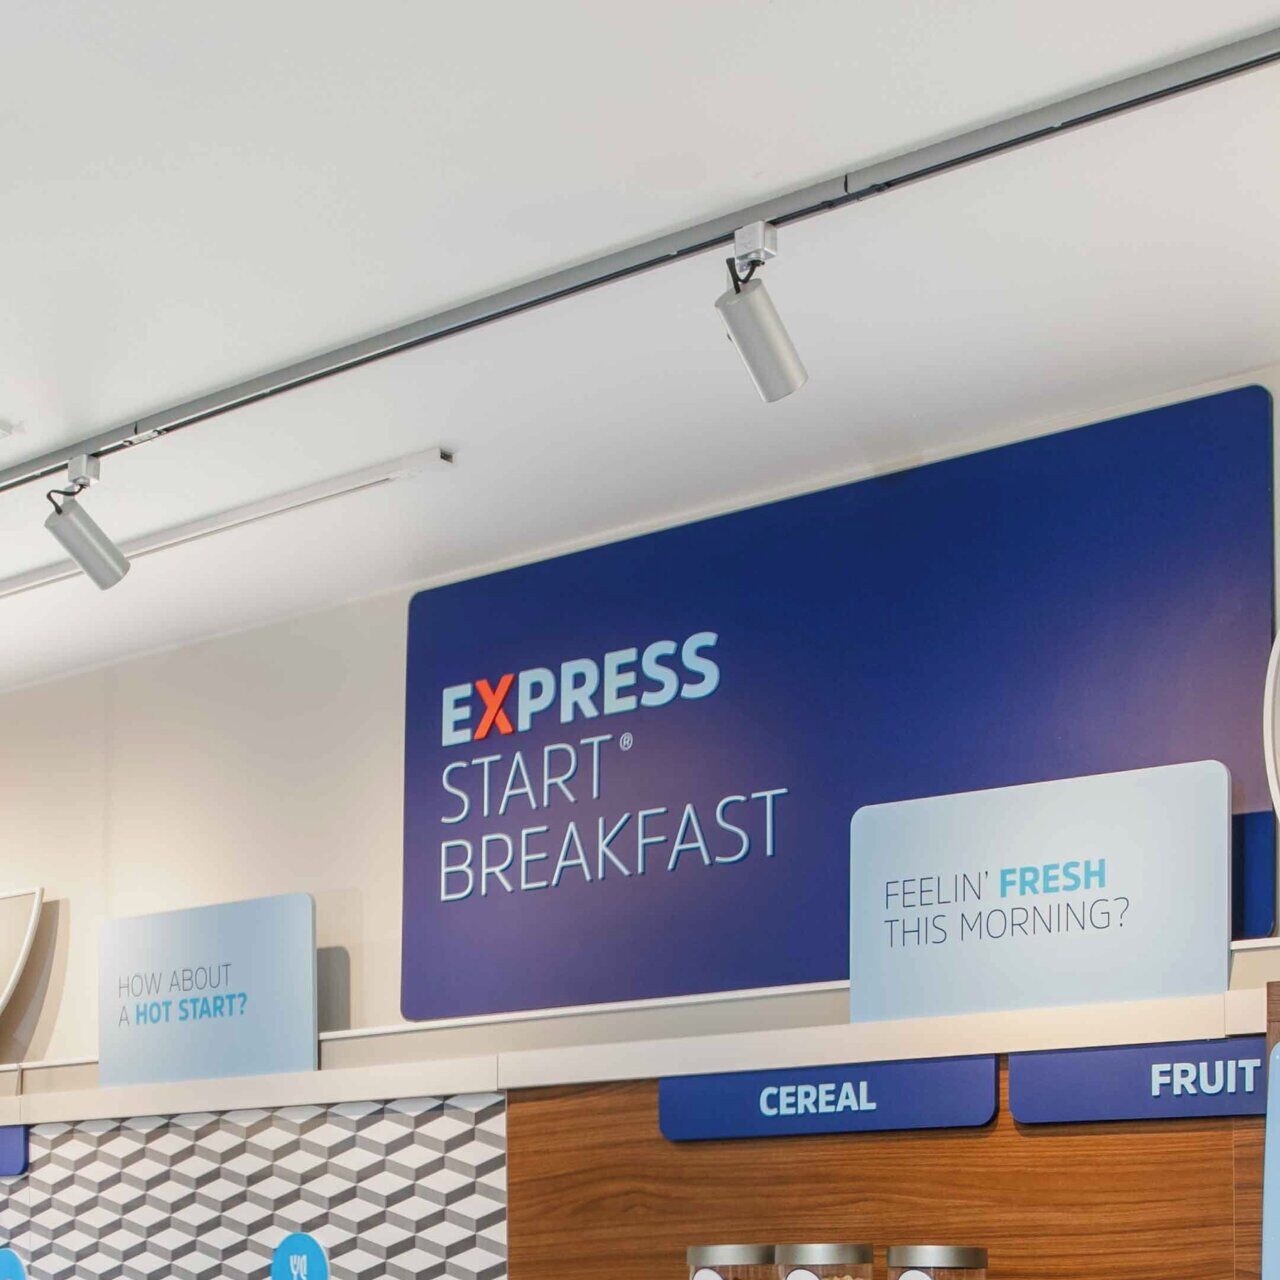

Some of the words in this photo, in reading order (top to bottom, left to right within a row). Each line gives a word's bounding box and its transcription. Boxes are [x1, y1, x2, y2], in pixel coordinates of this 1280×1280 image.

[441, 631, 720, 747] EXPRESS
[440, 787, 789, 902] BREAKFAST
[999, 858, 1106, 898] FRESH
[884, 914, 948, 948] THIS
[960, 896, 1130, 942] MORNING?
[118, 972, 162, 999] HOW
[169, 963, 232, 993] ABOUT
[118, 1005, 130, 1027] A
[135, 1001, 173, 1025] HOT
[178, 991, 248, 1021] START?
[1150, 1058, 1262, 1097] FRUIT
[759, 1080, 877, 1117] CEREAL
